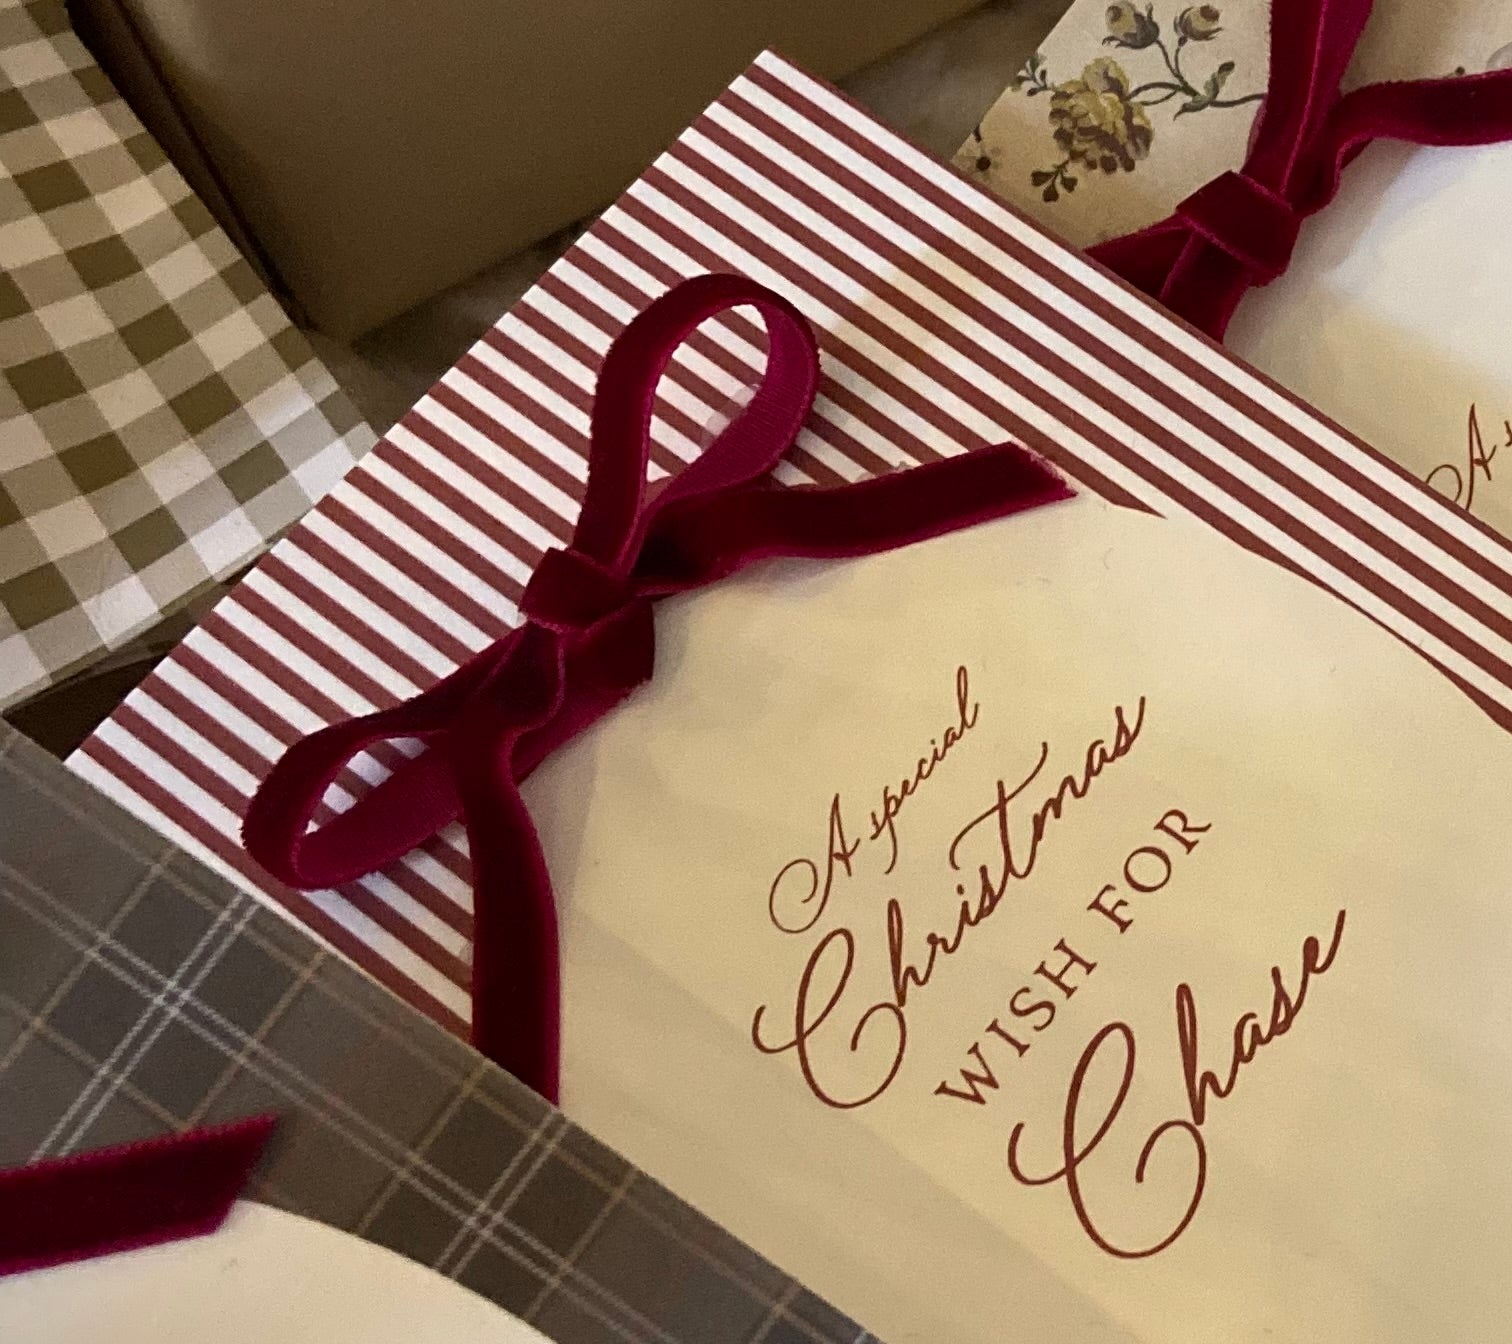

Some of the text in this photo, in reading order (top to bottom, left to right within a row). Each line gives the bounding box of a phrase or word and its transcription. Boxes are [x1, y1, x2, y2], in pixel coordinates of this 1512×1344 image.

[751, 695, 1146, 1109] Christmas
[768, 664, 980, 934] A special
[933, 807, 1213, 1107] WISH FOR
[1006, 908, 1347, 1260] Chase
